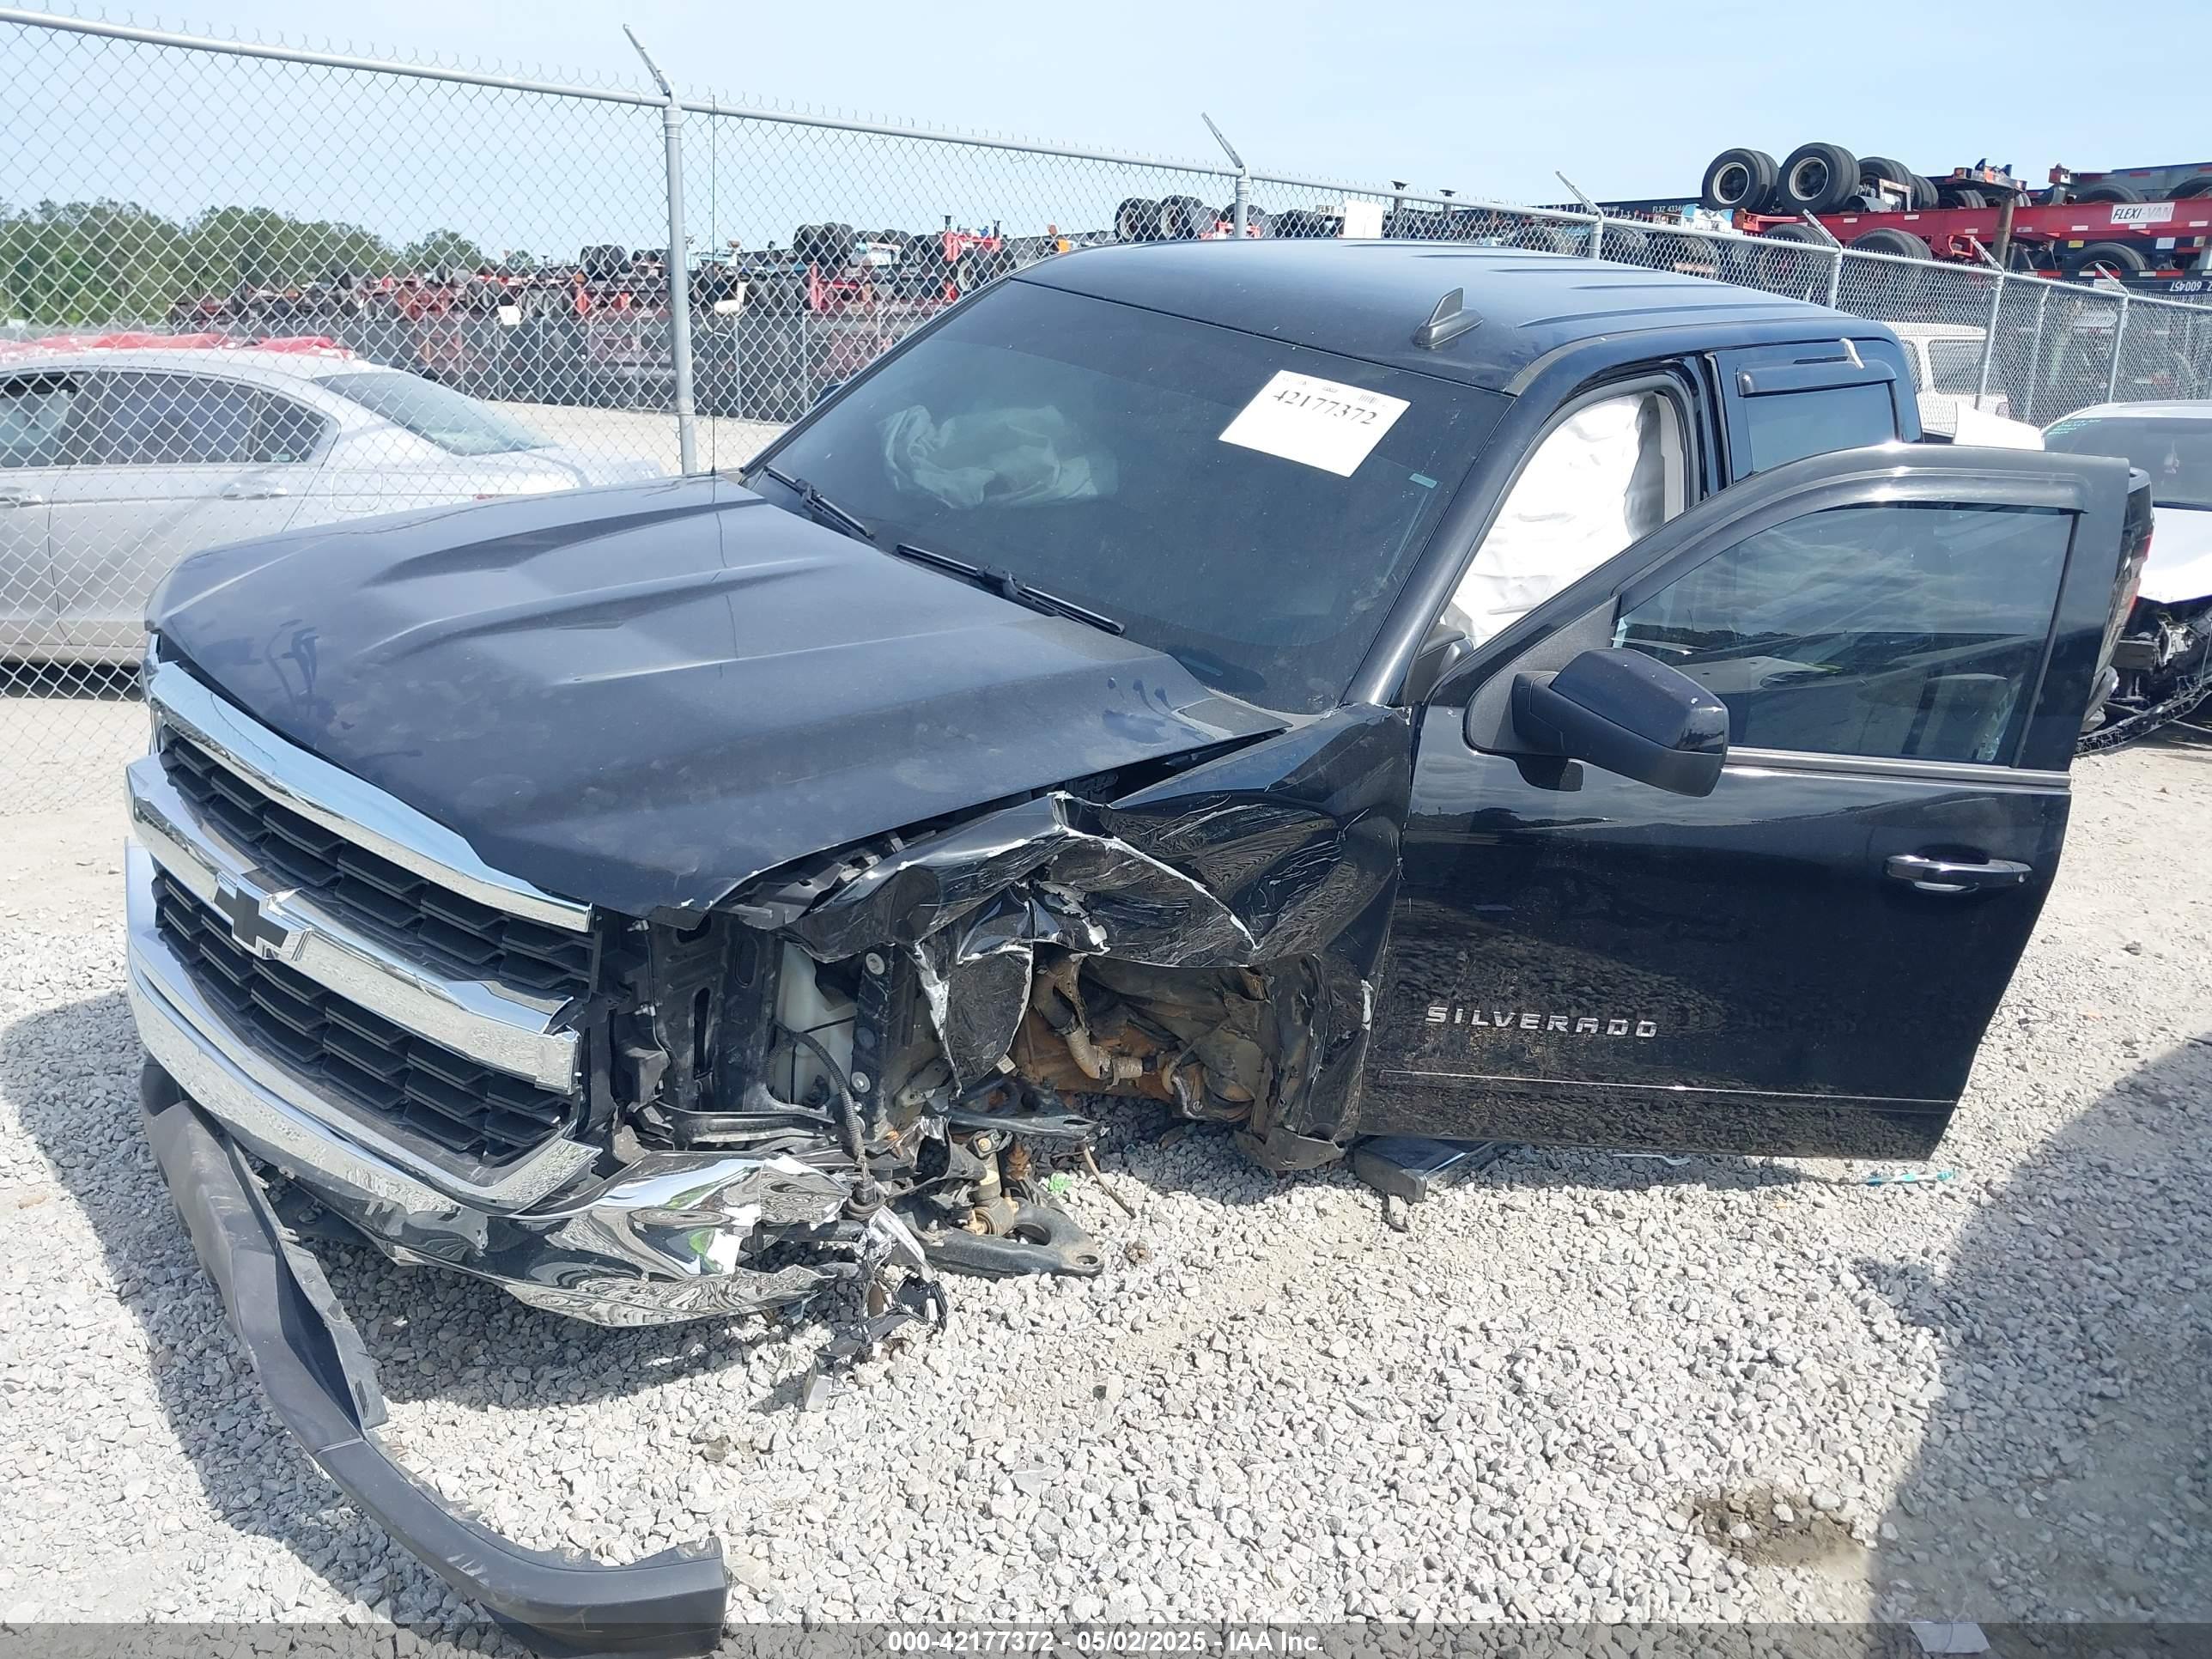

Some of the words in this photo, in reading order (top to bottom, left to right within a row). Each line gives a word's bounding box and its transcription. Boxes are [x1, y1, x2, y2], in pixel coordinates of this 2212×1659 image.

[2112, 206, 2172, 221] FLEXI-VAN
[1273, 389, 1378, 425] 42177372
[1425, 1006, 1658, 1038] SILVERADO
